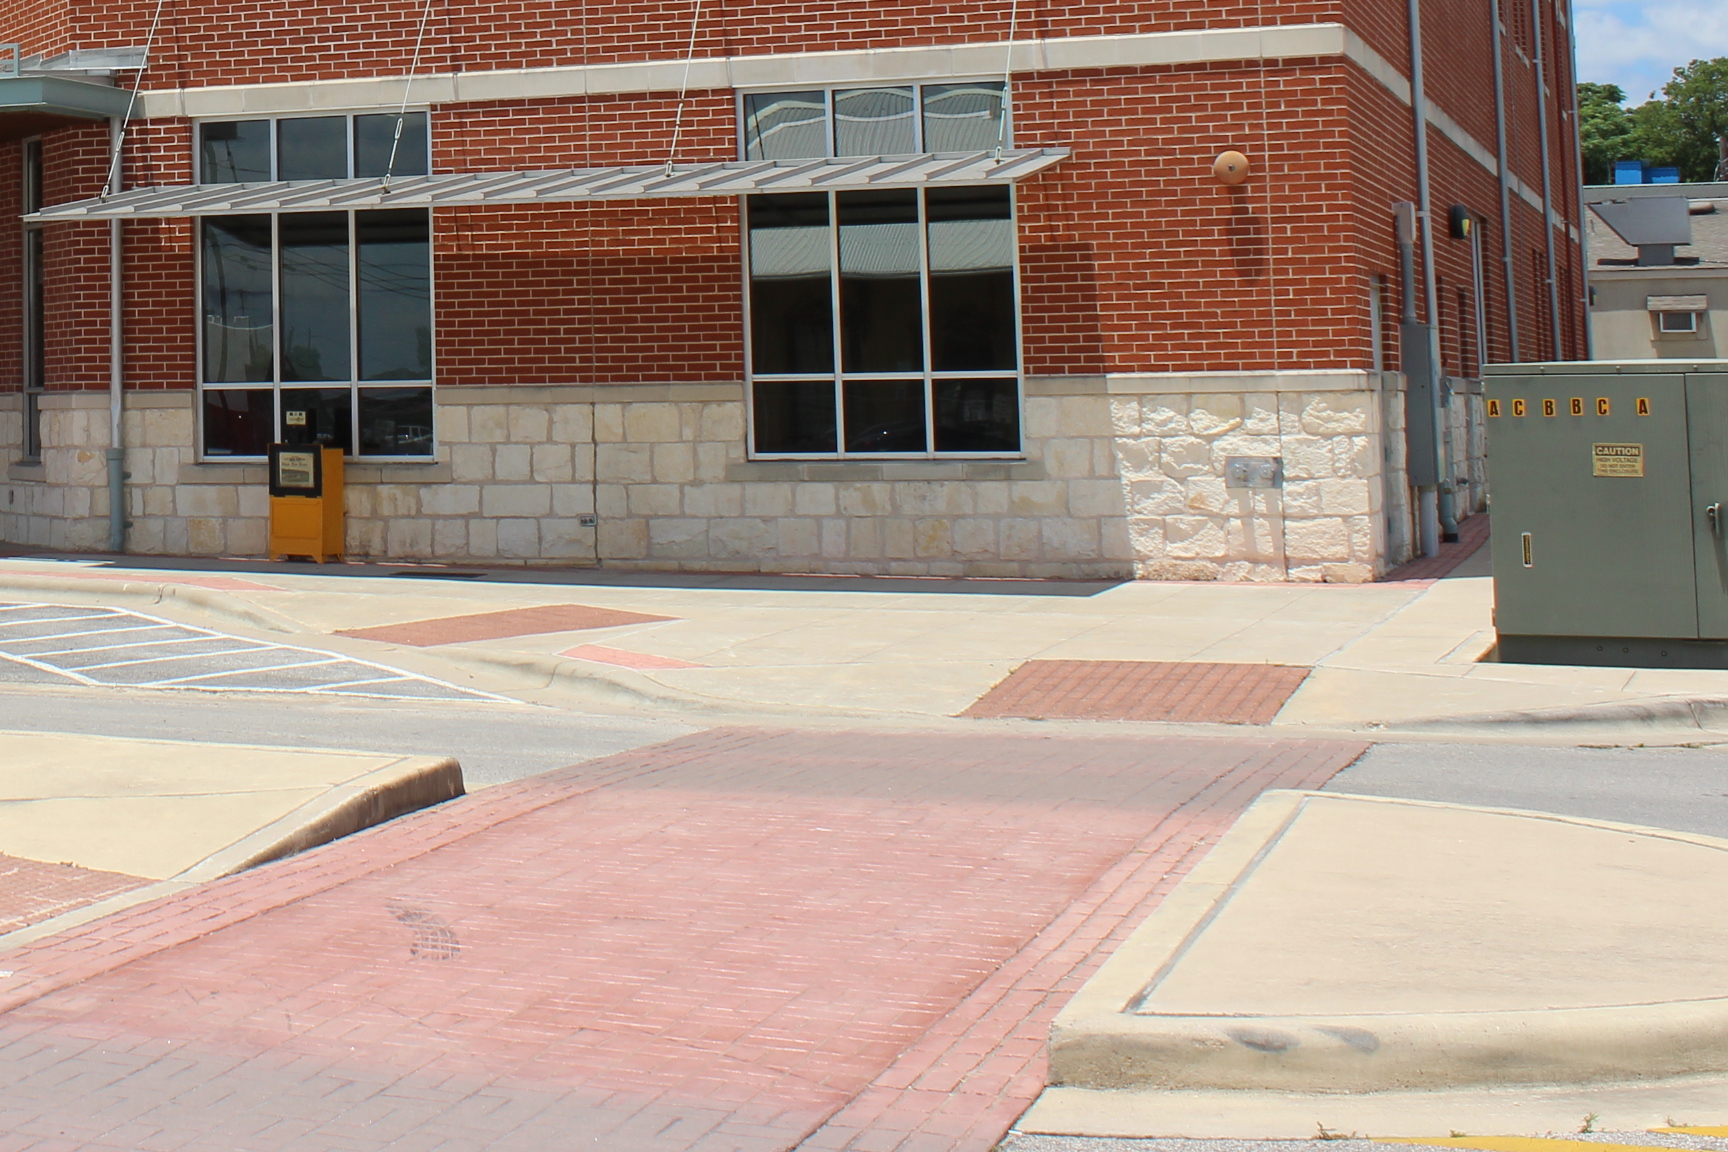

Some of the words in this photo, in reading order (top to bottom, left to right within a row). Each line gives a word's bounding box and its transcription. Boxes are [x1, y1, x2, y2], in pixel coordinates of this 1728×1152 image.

[1489, 400, 1498, 415] A
[1514, 400, 1523, 415] C
[1544, 400, 1554, 415] B
[1572, 399, 1581, 414] B
[1598, 399, 1607, 414] C
[1638, 399, 1648, 414] A
[1596, 447, 1639, 455] CAUTION
